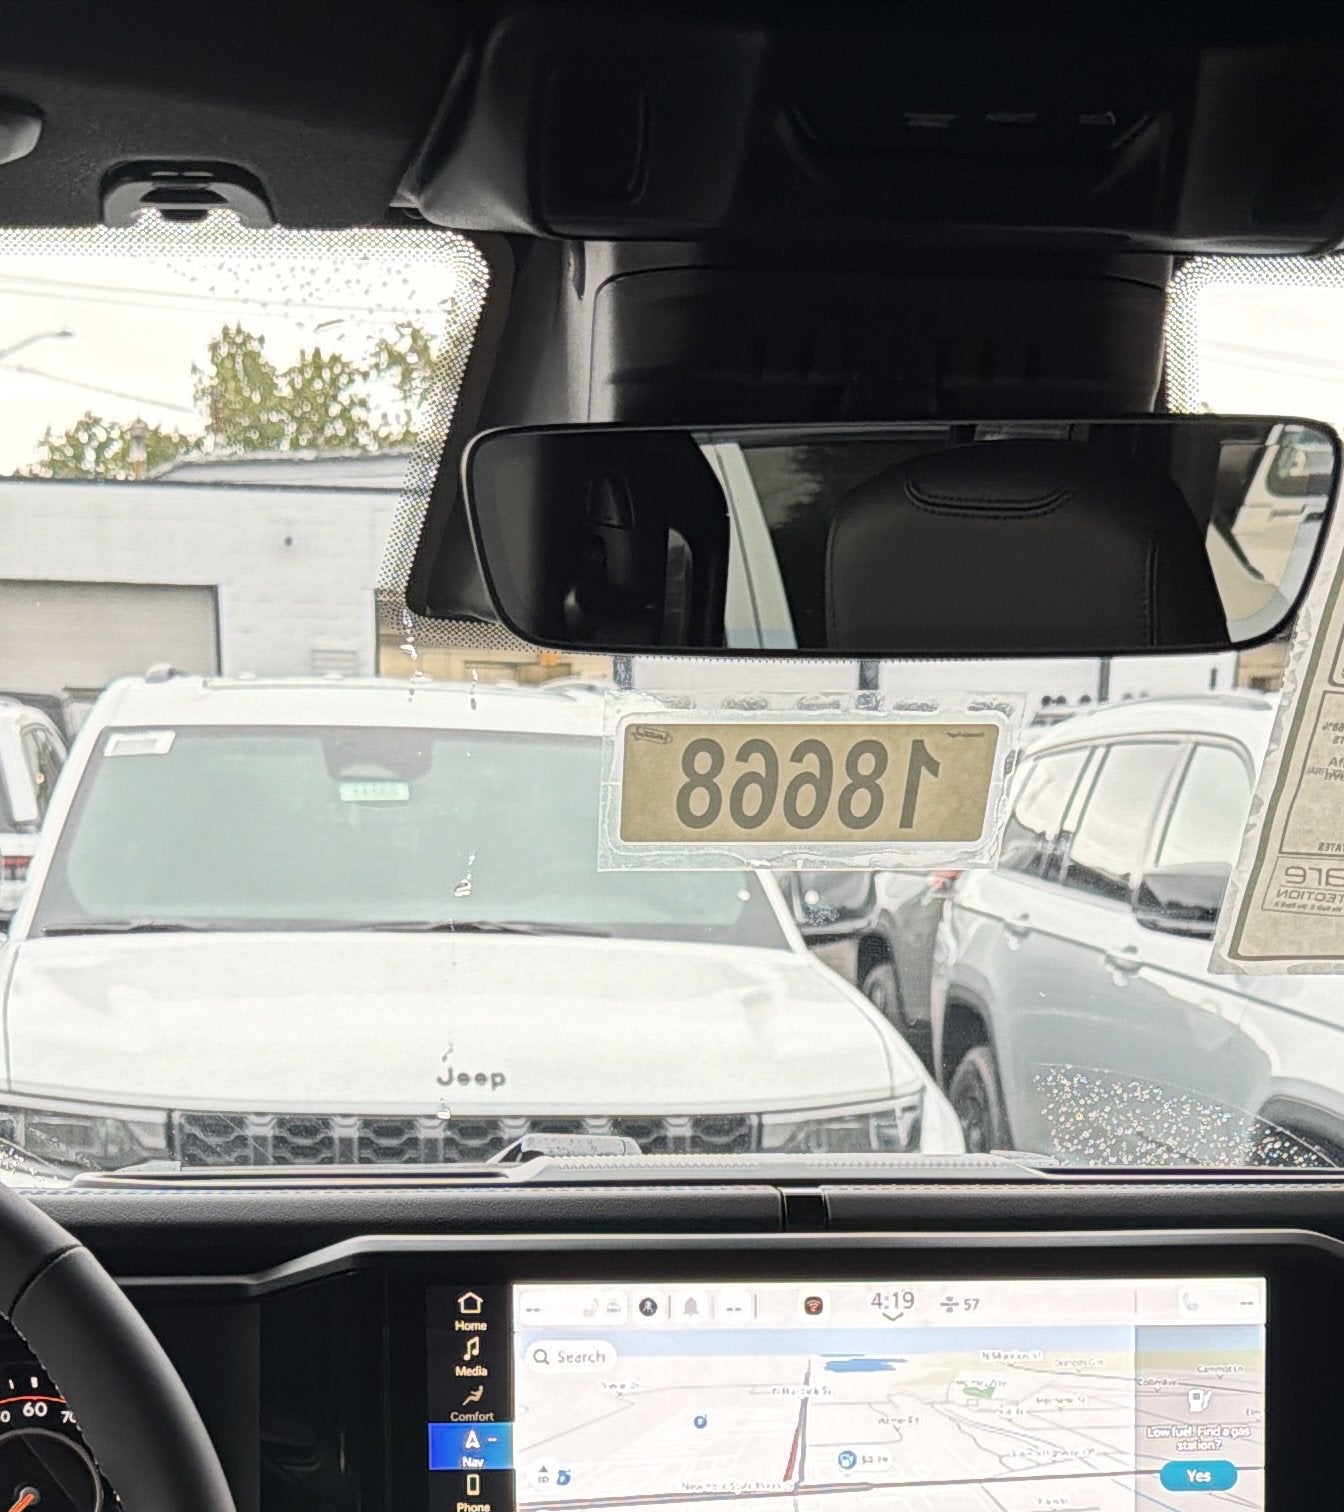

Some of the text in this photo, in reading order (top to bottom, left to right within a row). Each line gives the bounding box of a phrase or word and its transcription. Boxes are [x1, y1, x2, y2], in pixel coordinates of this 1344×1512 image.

[436, 1066, 507, 1091] Jeep
[869, 1291, 915, 1310] 4:19
[454, 1320, 488, 1331] Home
[557, 1349, 606, 1364] Search
[455, 1365, 488, 1377] Media
[22, 1401, 49, 1418] 60
[450, 1410, 495, 1422] Comfort
[1146, 1424, 1252, 1440] Low Find gas
[1175, 1440, 1223, 1452] station?
[462, 1456, 485, 1468] Nav
[1186, 1468, 1212, 1483] Yes
[456, 1502, 491, 1512] Phone
